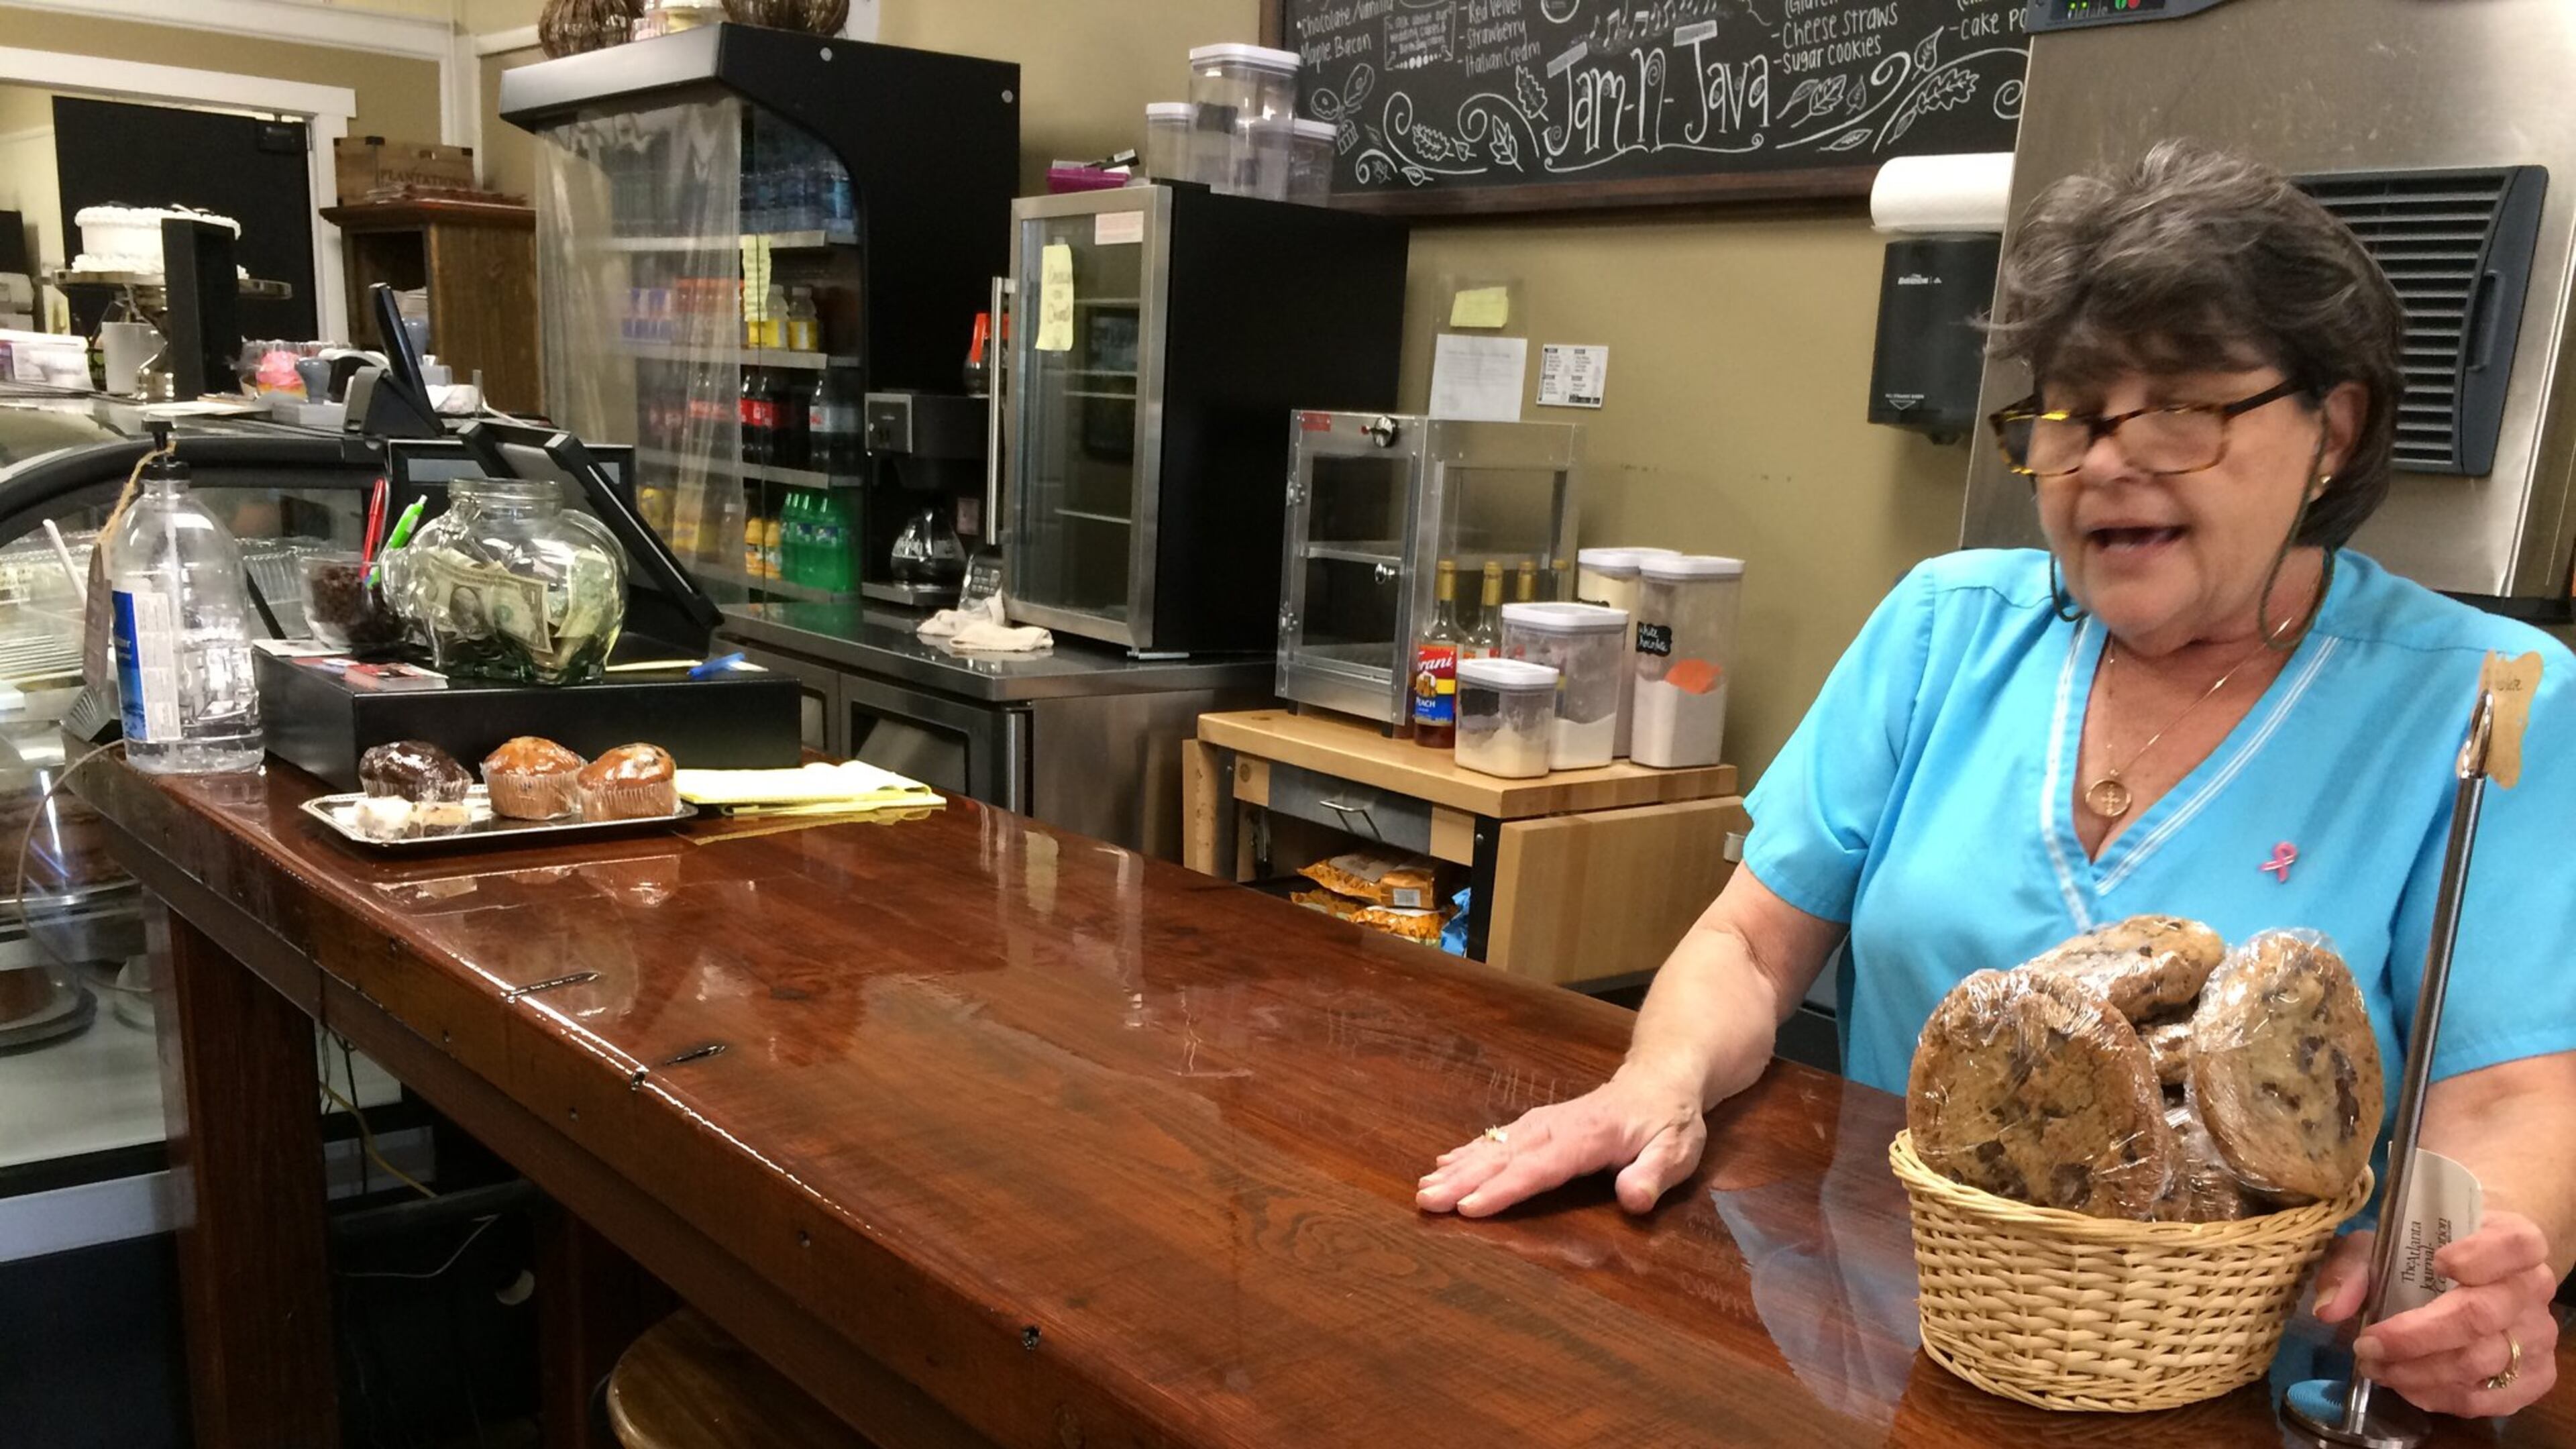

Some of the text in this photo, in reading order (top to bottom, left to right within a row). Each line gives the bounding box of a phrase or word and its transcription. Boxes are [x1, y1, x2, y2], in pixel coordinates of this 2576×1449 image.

[1783, 15, 1837, 50] Cheese
[1783, 34, 1881, 74] sugar cookies
[1417, 650, 1454, 671] rani
